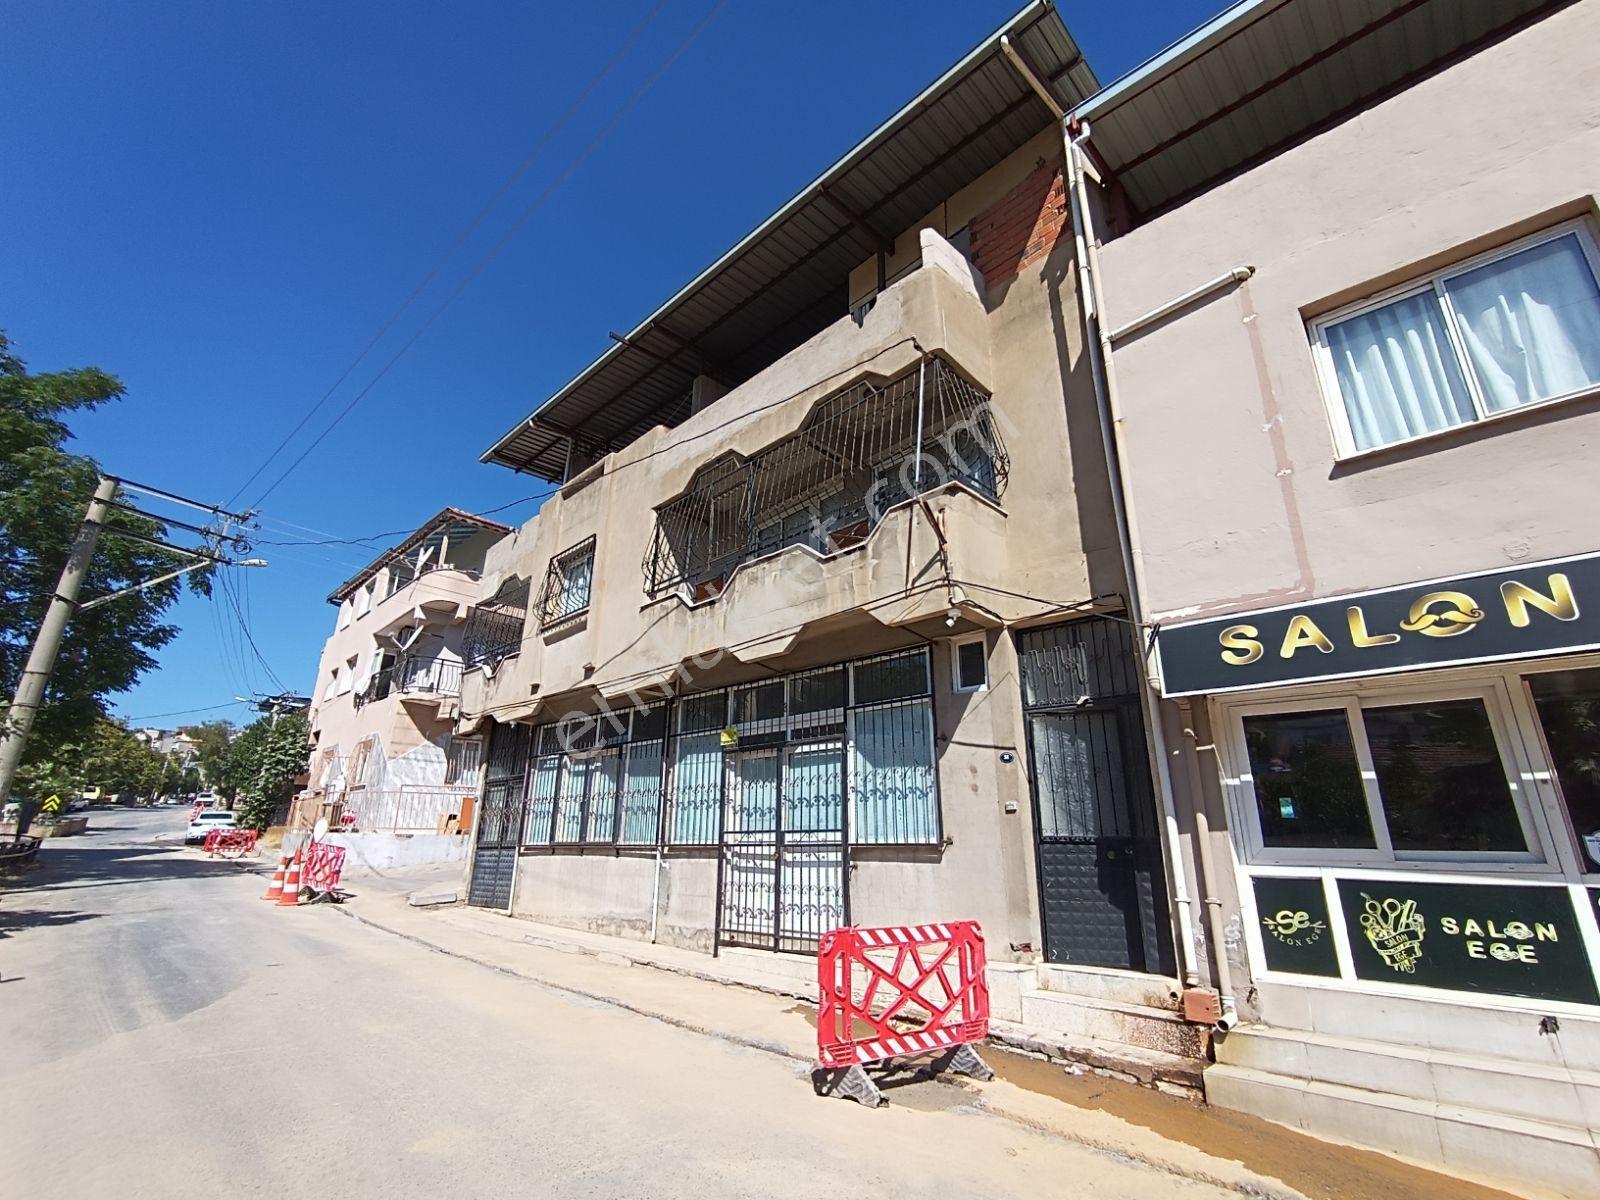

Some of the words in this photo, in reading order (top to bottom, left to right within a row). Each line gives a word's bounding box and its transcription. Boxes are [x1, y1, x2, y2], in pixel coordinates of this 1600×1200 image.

[1219, 573, 1580, 665] SALON
[1441, 917, 1558, 942] SALON
[1384, 933, 1409, 948] SALON
[1393, 950, 1408, 962] EGE
